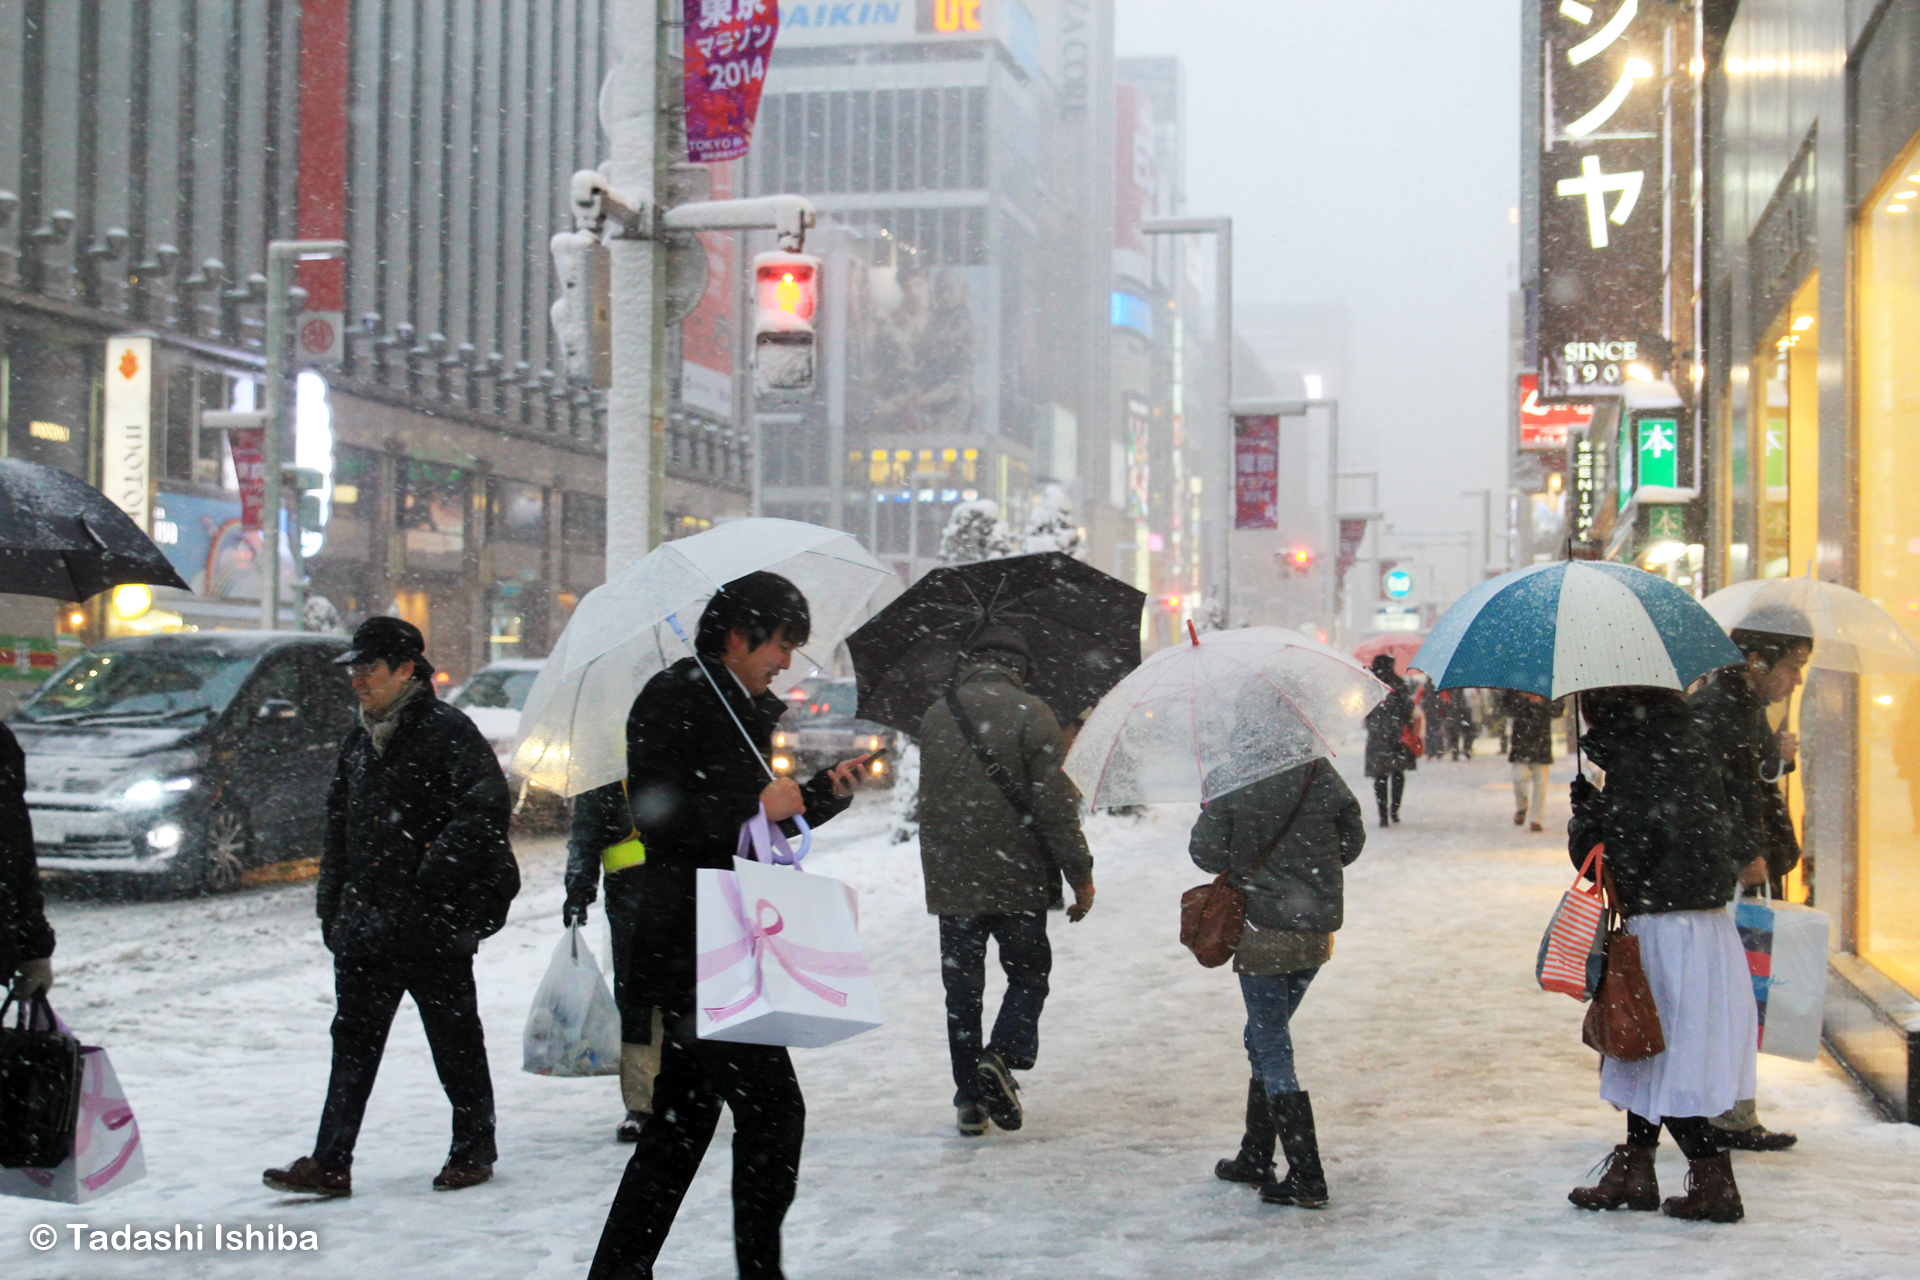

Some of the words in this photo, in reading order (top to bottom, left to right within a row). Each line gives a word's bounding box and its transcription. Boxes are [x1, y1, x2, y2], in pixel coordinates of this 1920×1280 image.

[696, 25, 772, 59] マラソン
[709, 55, 764, 91] 2014
[689, 138, 732, 151] TOKYO
[1564, 341, 1638, 362] SINCE
[1565, 363, 1620, 383] 190
[1578, 453, 1593, 529] ZENITH
